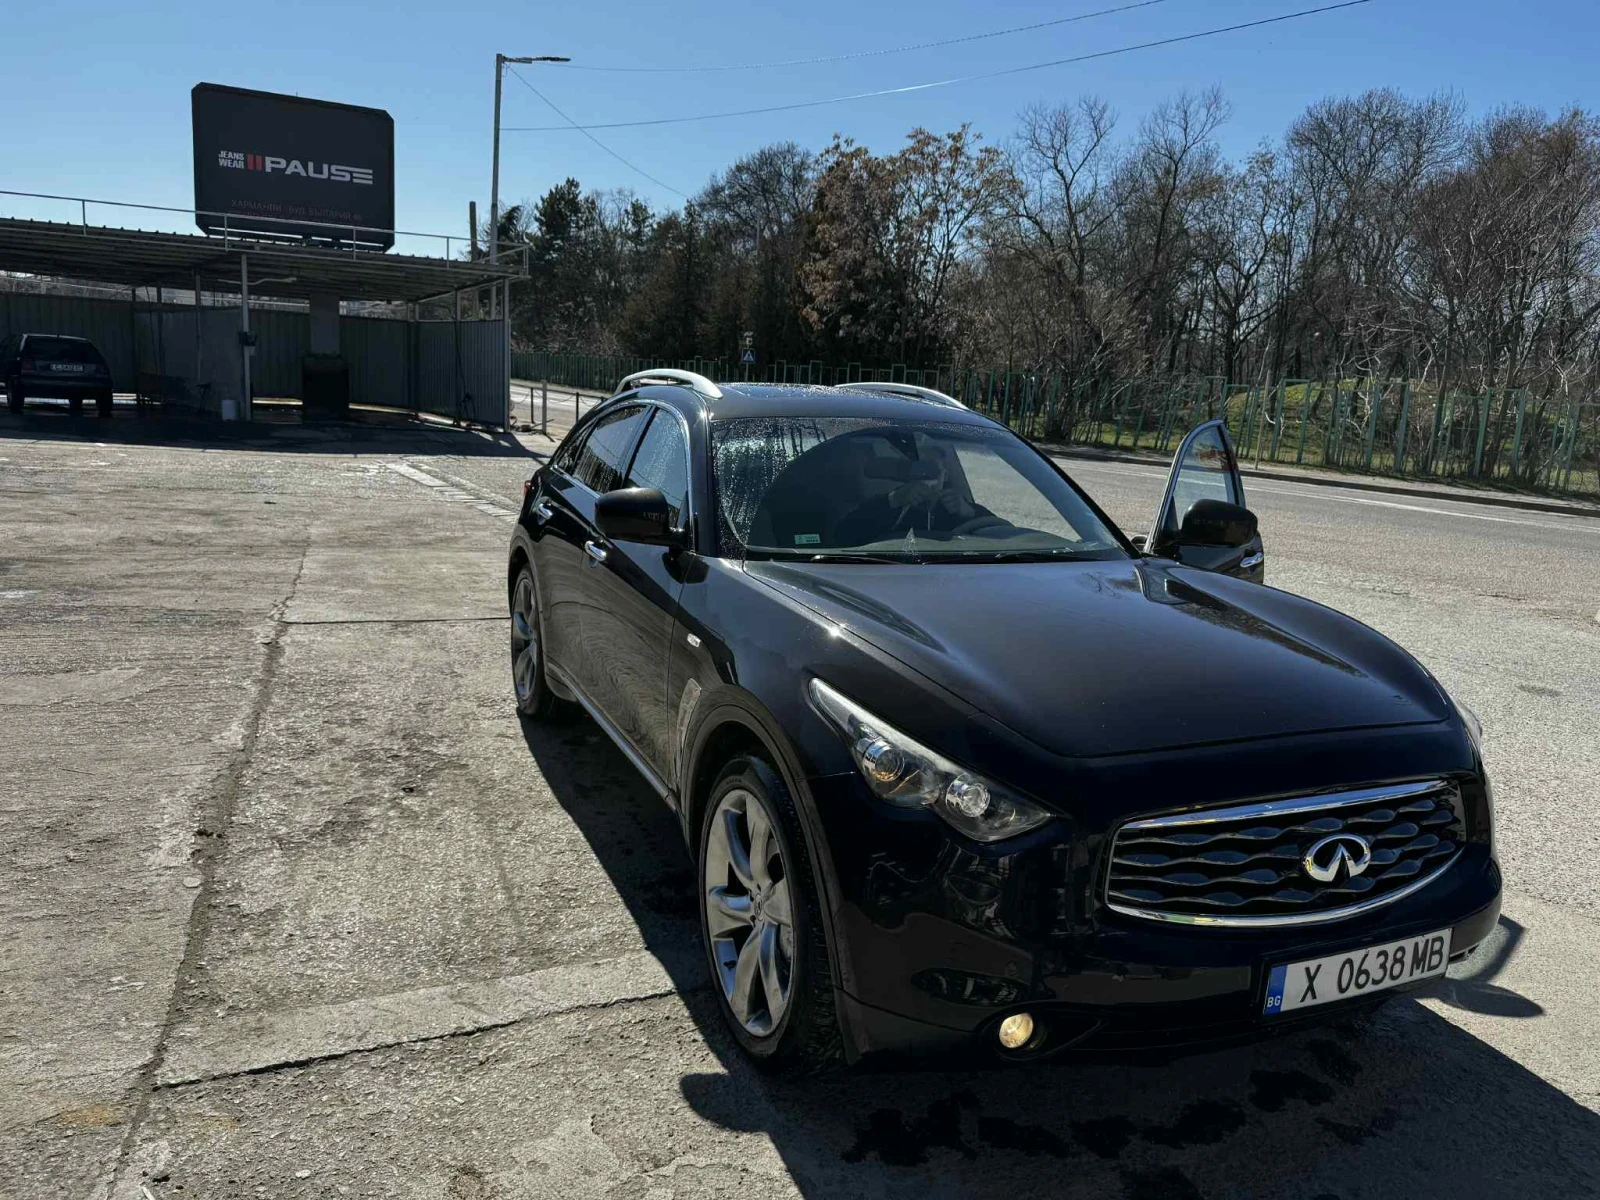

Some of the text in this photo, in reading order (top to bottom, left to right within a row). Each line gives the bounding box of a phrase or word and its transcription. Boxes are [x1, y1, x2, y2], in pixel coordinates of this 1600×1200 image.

[218, 150, 245, 161] JEANS
[218, 158, 245, 169] WEAR
[264, 156, 374, 185] PAUSE
[1266, 995, 1282, 1008] BG
